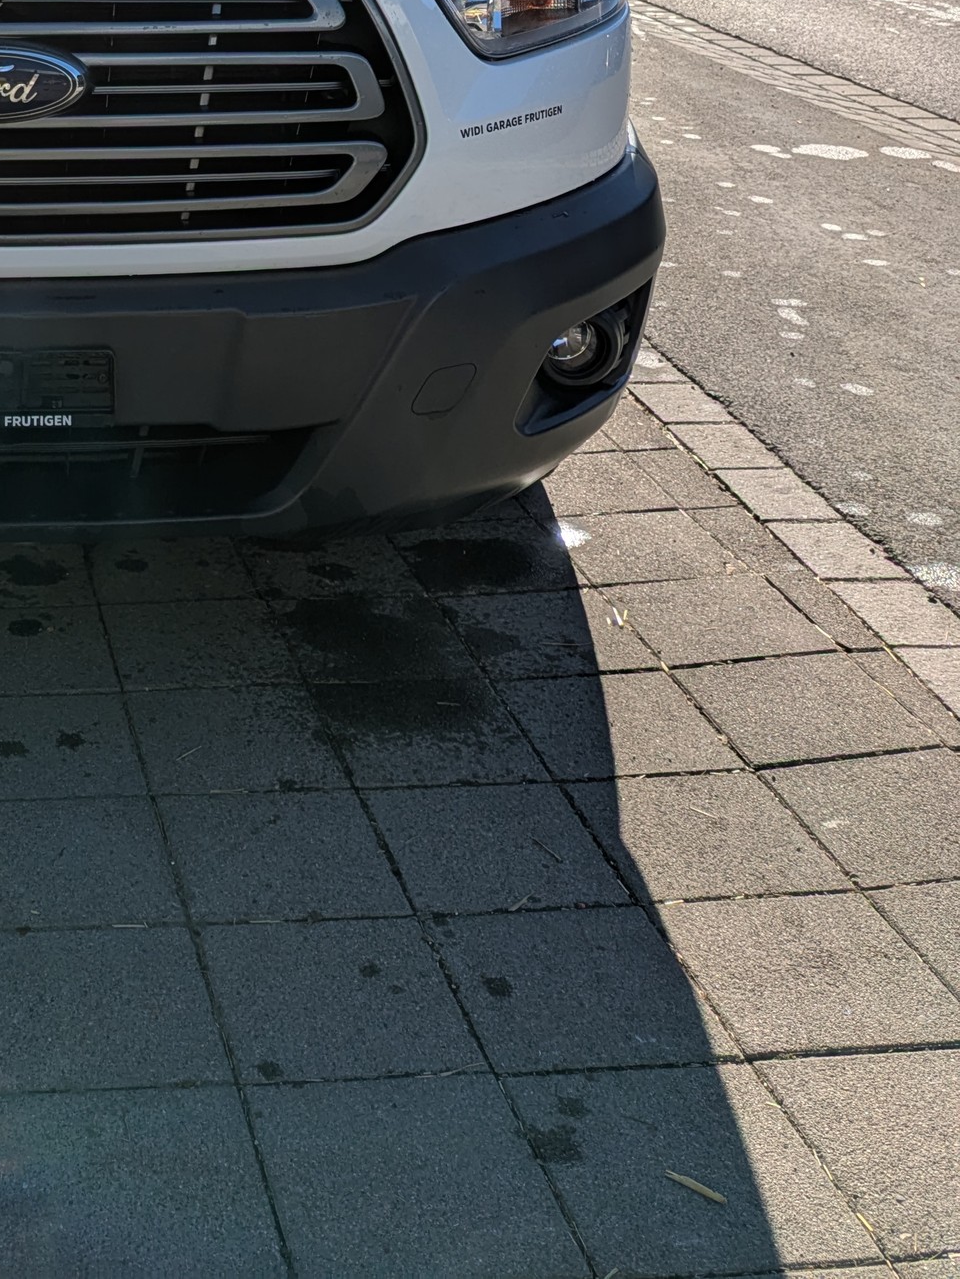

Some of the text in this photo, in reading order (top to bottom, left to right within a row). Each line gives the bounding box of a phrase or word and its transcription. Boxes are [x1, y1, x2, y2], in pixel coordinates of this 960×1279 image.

[460, 105, 562, 138] WIDI GARAGE FRUTIGEN
[4, 414, 73, 427] FRUTIGEN
